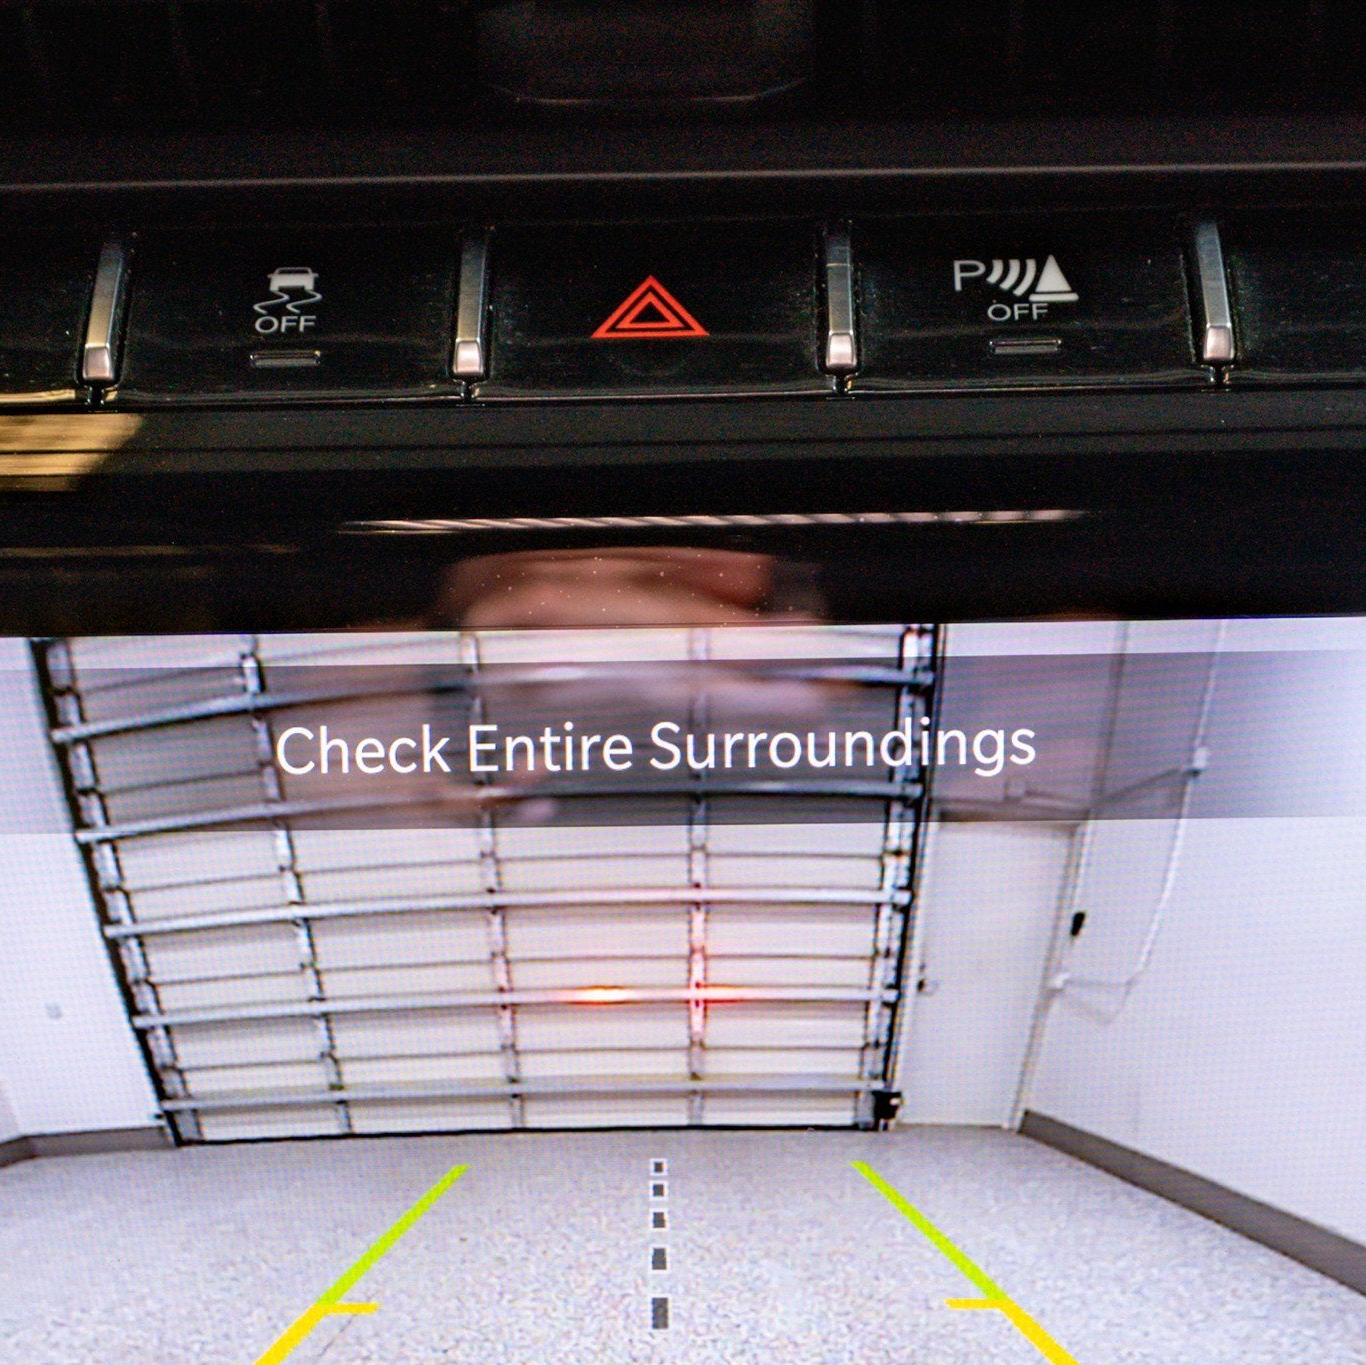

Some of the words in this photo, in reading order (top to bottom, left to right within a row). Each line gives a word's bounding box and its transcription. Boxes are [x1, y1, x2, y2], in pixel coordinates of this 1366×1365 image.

[987, 302, 1049, 321] OFF
[255, 315, 317, 333] OFF
[276, 723, 452, 776] Check
[468, 721, 633, 773] Entire
[649, 716, 1037, 778] Surroundings
